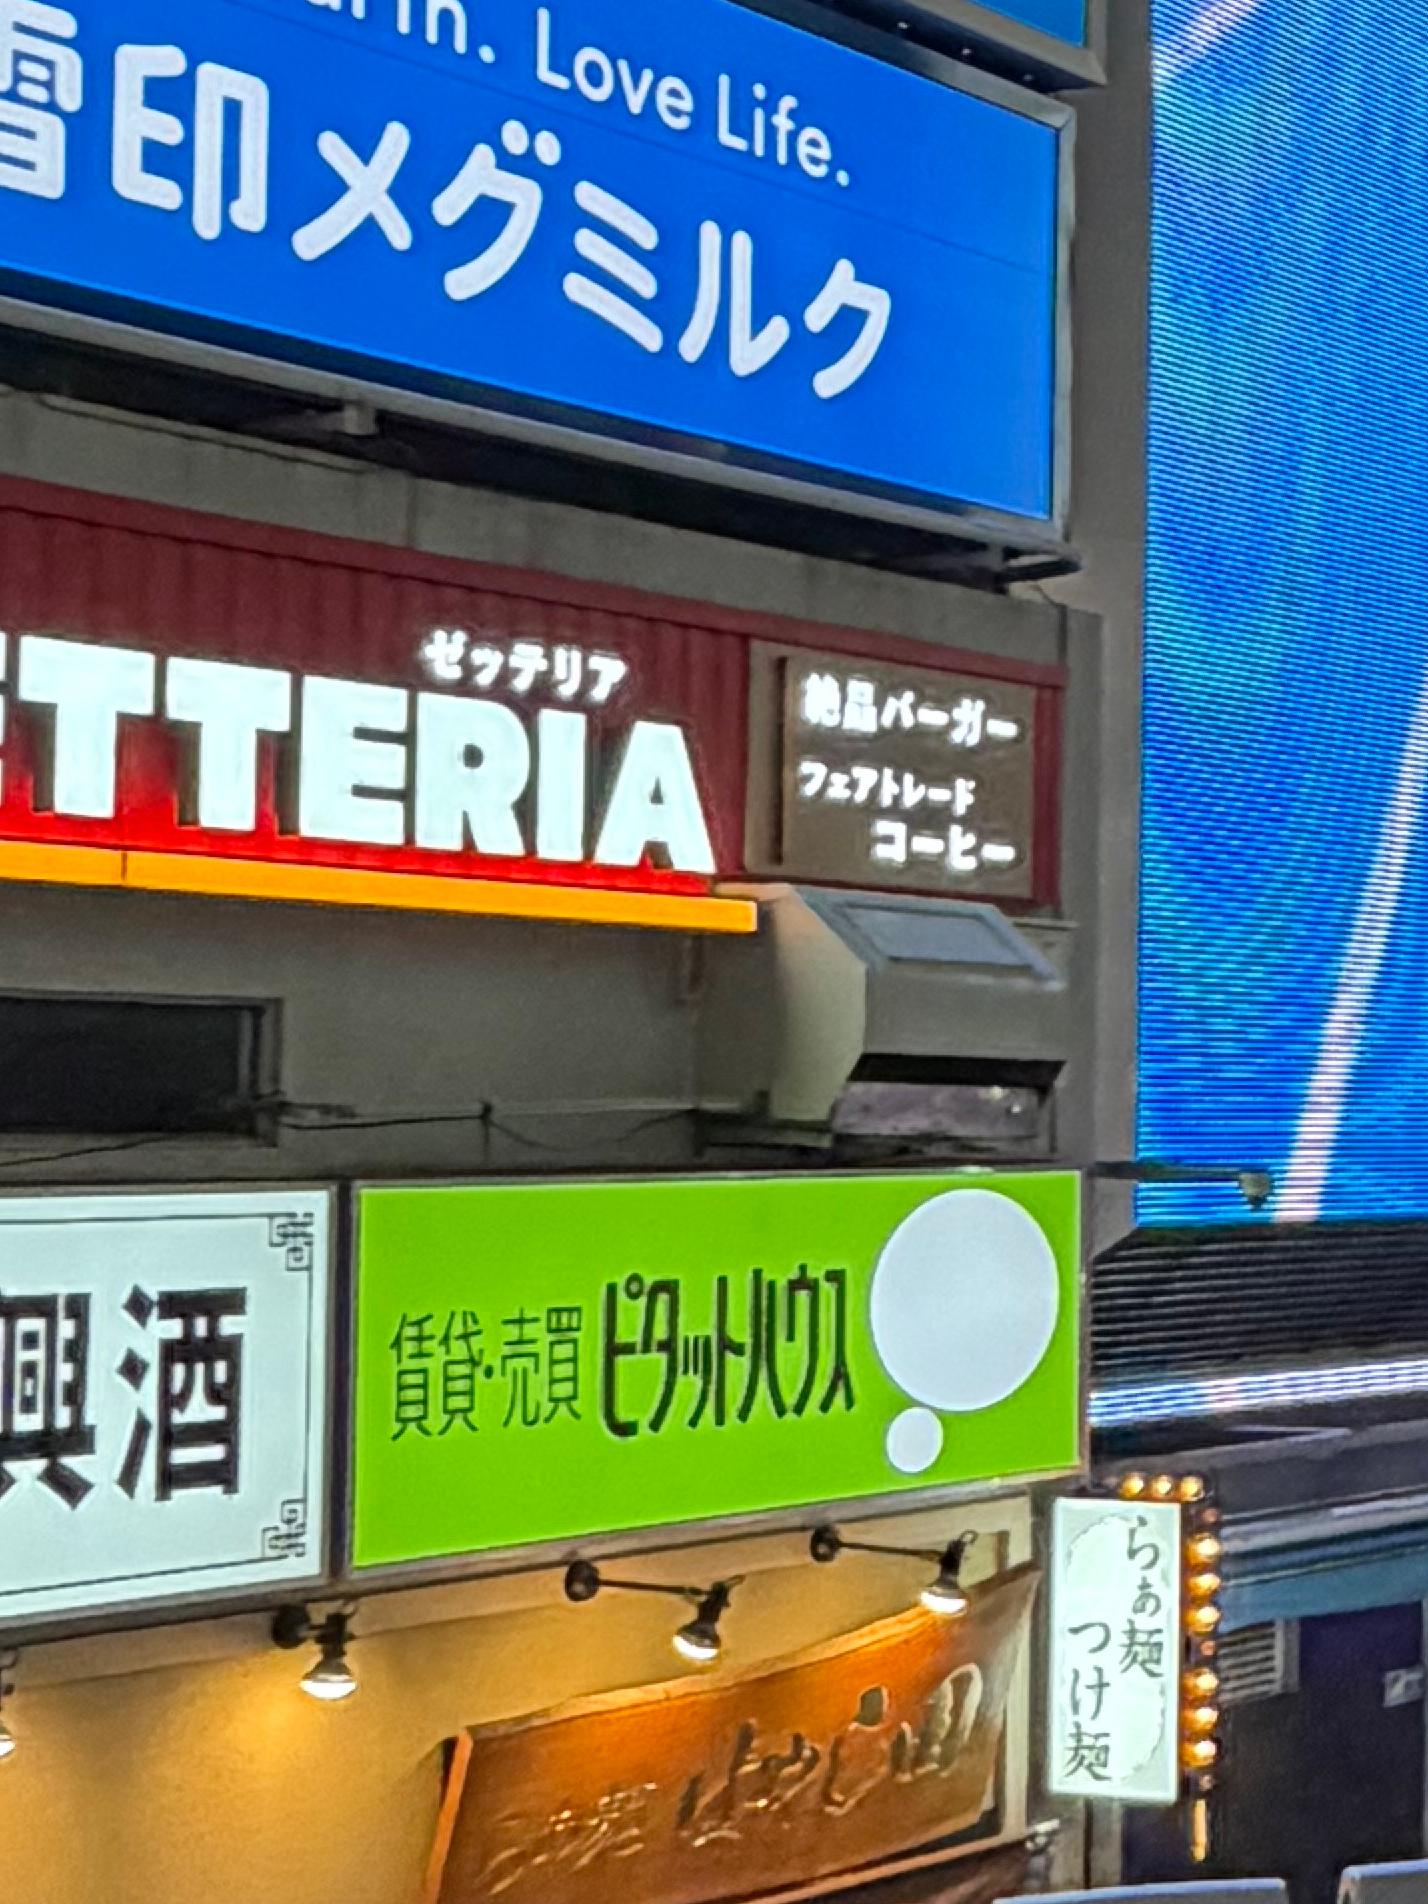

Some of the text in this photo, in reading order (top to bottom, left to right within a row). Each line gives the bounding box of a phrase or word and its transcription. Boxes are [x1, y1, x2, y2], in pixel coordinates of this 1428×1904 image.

[535, 7, 694, 131] Love
[717, 73, 850, 187] Life.
[423, 628, 628, 703] ゼッテリア
[803, 670, 1020, 748] 絶品バーガー
[0, 630, 719, 874] TTERIA
[798, 760, 976, 816] フェアトレード
[869, 817, 1018, 872] コーヒー
[390, 1262, 856, 1441] 賃貸・売買 ピタットハウス
[1118, 1514, 1164, 1679] らぁ麺
[1064, 1620, 1112, 1782] つけ麺
